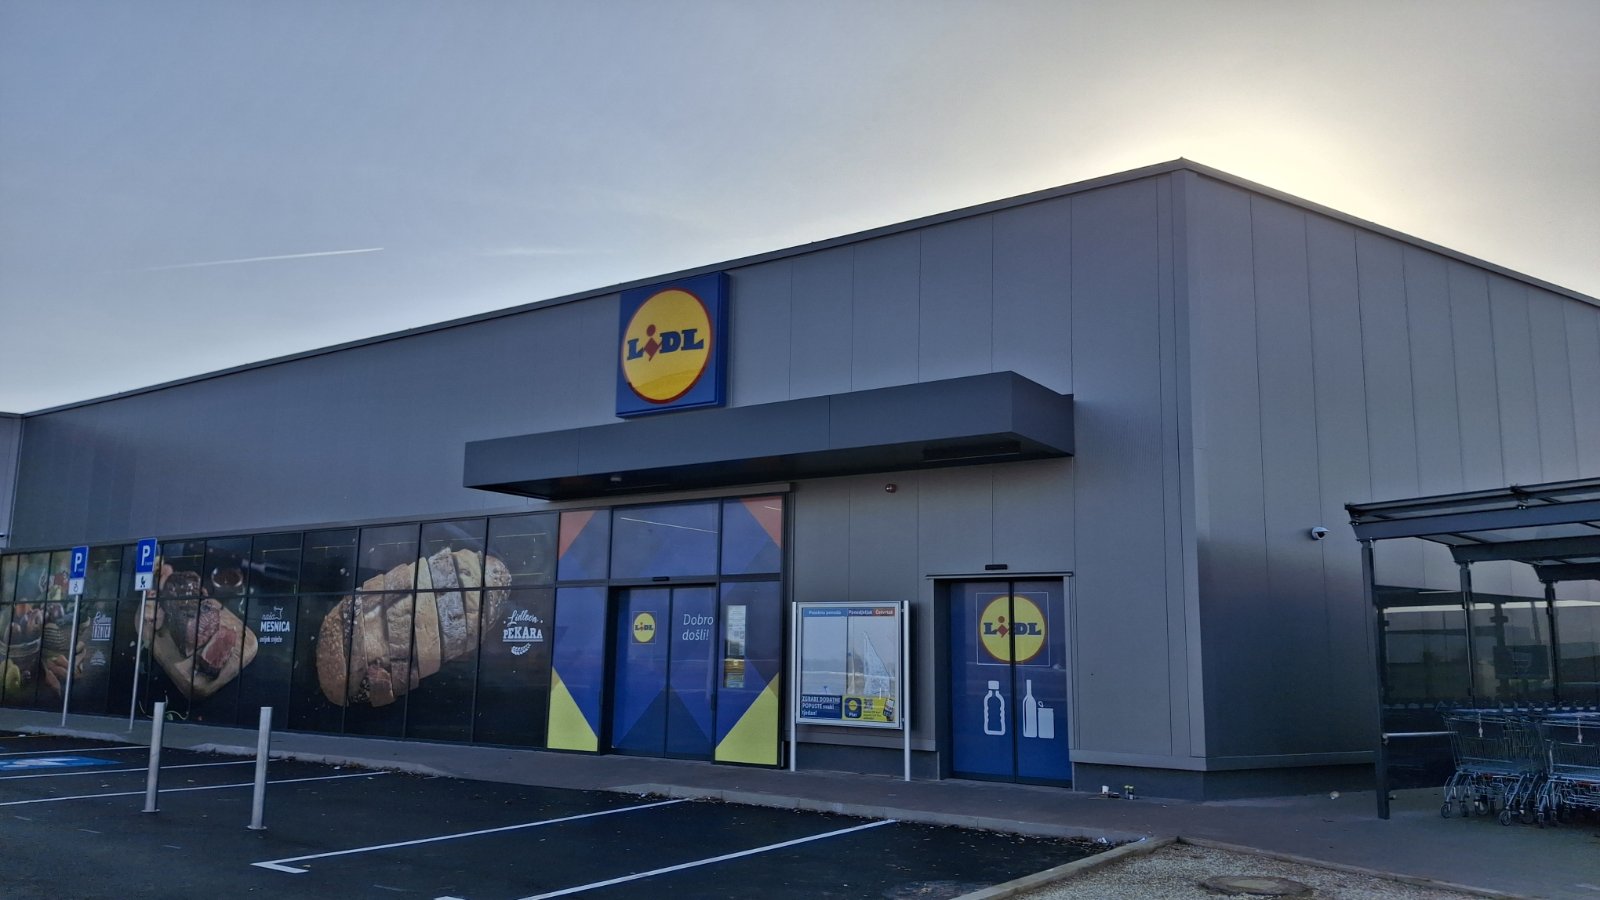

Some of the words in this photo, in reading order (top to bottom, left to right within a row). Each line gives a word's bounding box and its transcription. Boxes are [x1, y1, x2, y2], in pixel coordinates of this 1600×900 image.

[141, 545, 151, 566] P
[74, 553, 83, 572] P
[683, 613, 714, 626] Dobro
[260, 621, 290, 632] MESNICA
[503, 626, 543, 639] PEKARA
[682, 629, 709, 641] došli!
